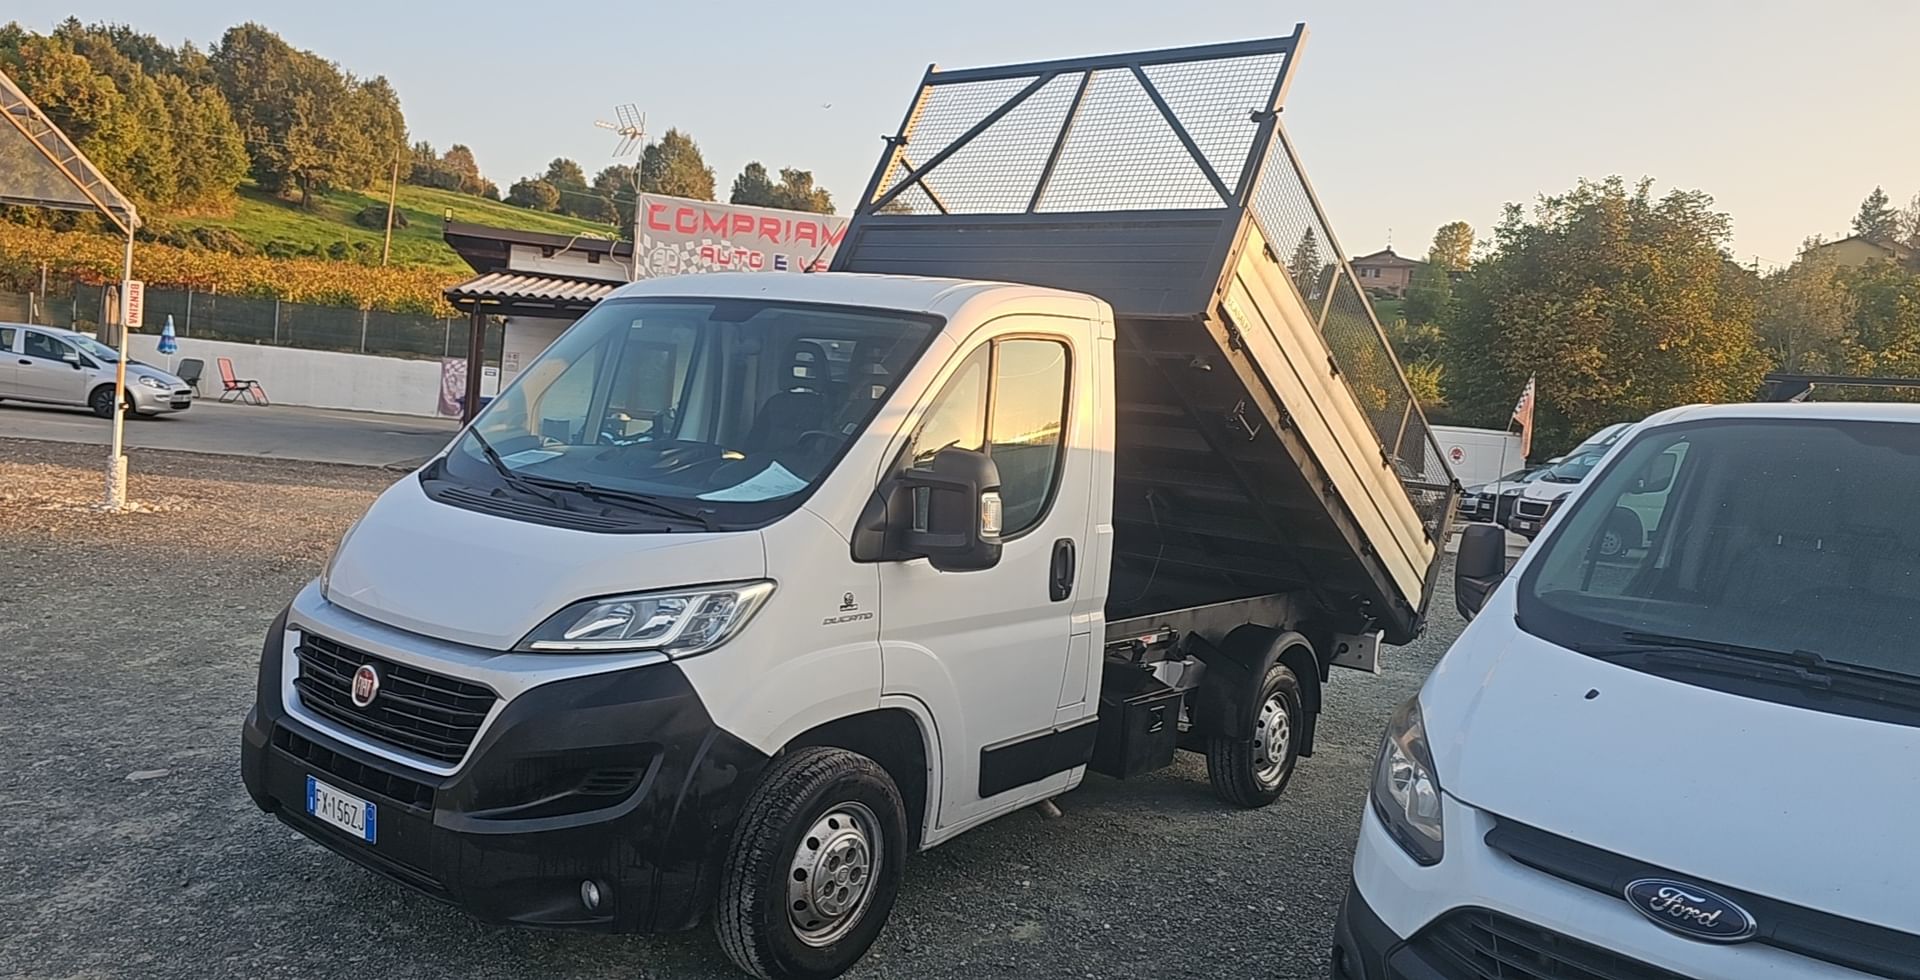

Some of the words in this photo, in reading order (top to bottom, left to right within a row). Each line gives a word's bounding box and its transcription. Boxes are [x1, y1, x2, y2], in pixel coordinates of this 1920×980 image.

[700, 247, 763, 269] AUTO
[774, 255, 788, 271] E
[128, 283, 140, 324] BENZINA
[822, 612, 874, 626] DUCATO
[1649, 886, 1722, 928] Ford
